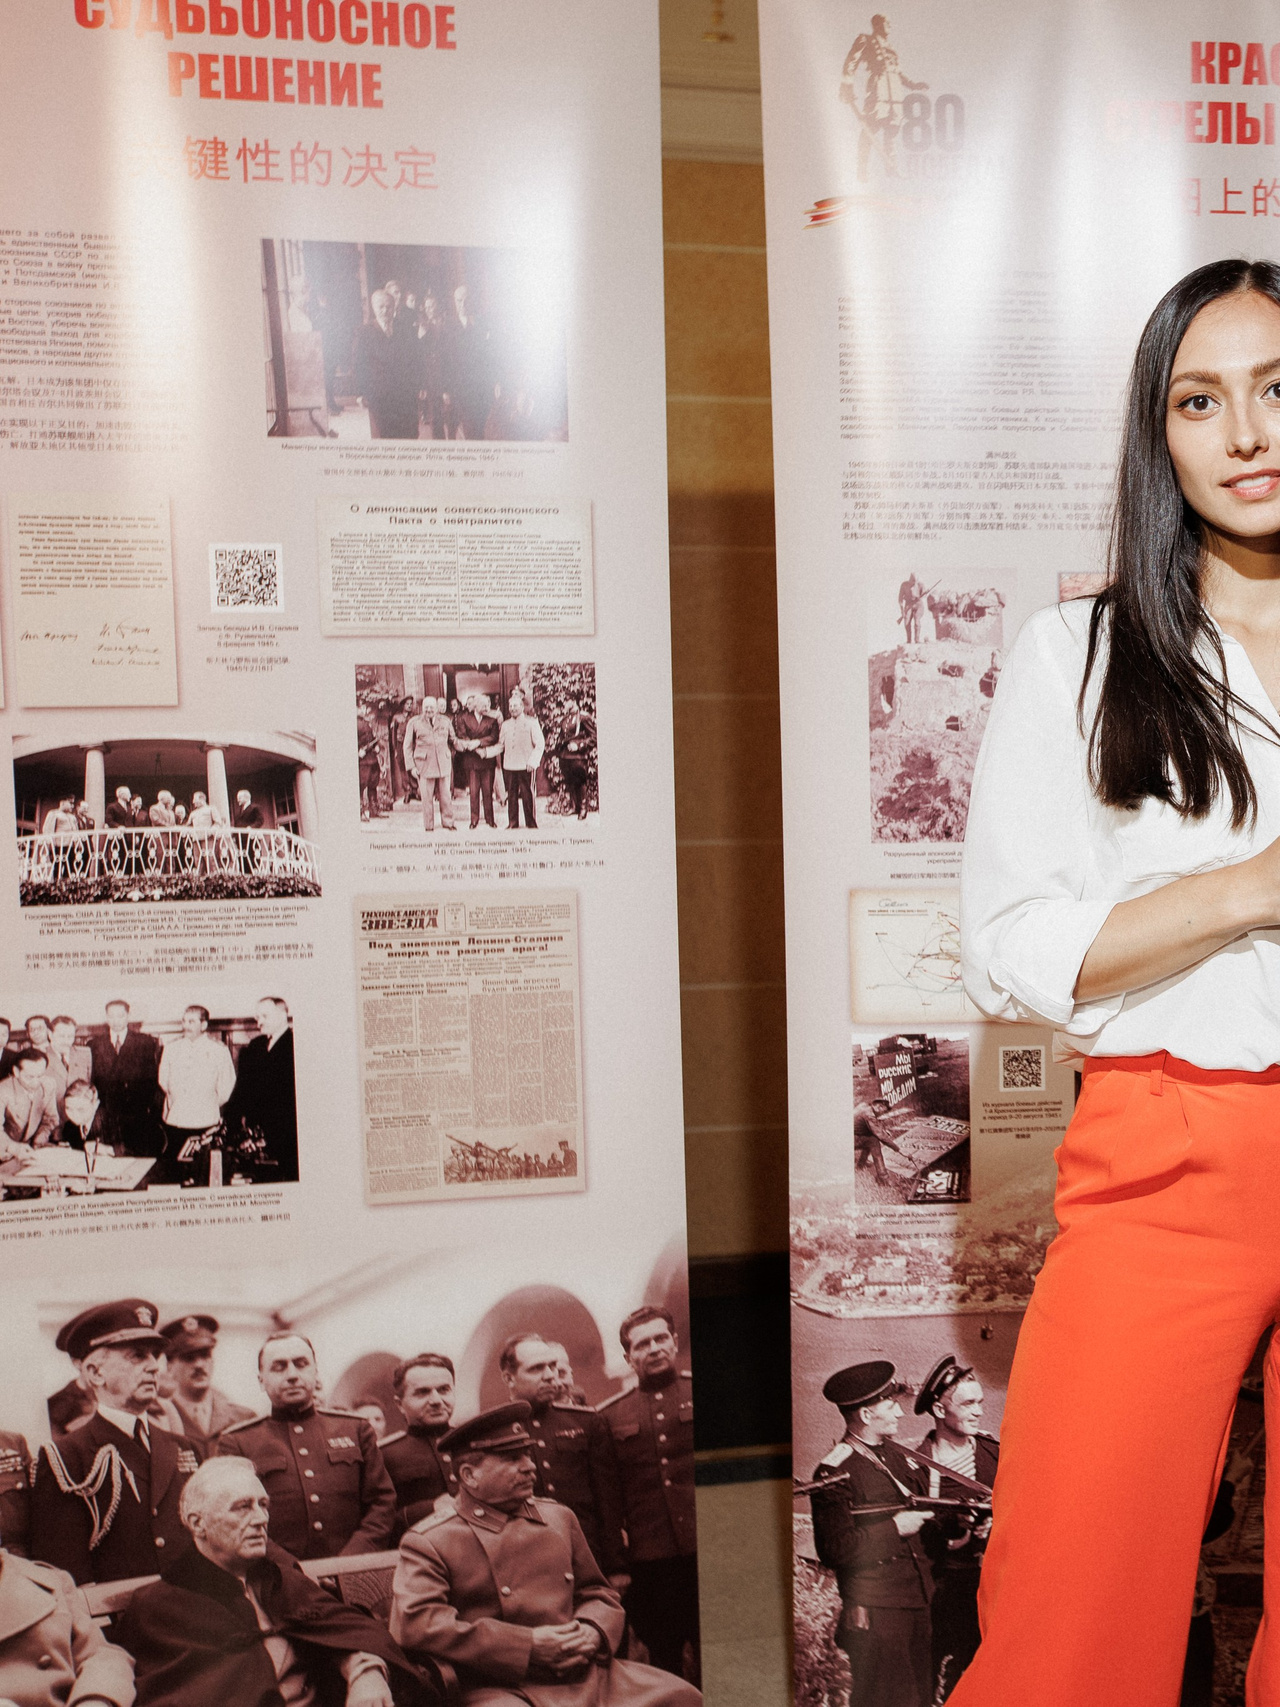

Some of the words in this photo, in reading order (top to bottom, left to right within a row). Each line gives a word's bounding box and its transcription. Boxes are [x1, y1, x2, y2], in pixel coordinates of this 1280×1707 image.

[169, 53, 383, 108] РЕШЕНИЕ
[902, 93, 965, 153] 80
[361, 909, 438, 919] ТИХООКЕАНСКАЯ
[361, 918, 438, 931] ЗВЕЗДА
[369, 941, 393, 950] Под
[400, 940, 460, 949] знаменем
[468, 935, 563, 945] Ленина-Сталина
[457, 947, 505, 957] разгром
[512, 943, 548, 955] врага!
[896, 1054, 911, 1065] МЫ
[878, 1064, 912, 1079] РУССКИЕ
